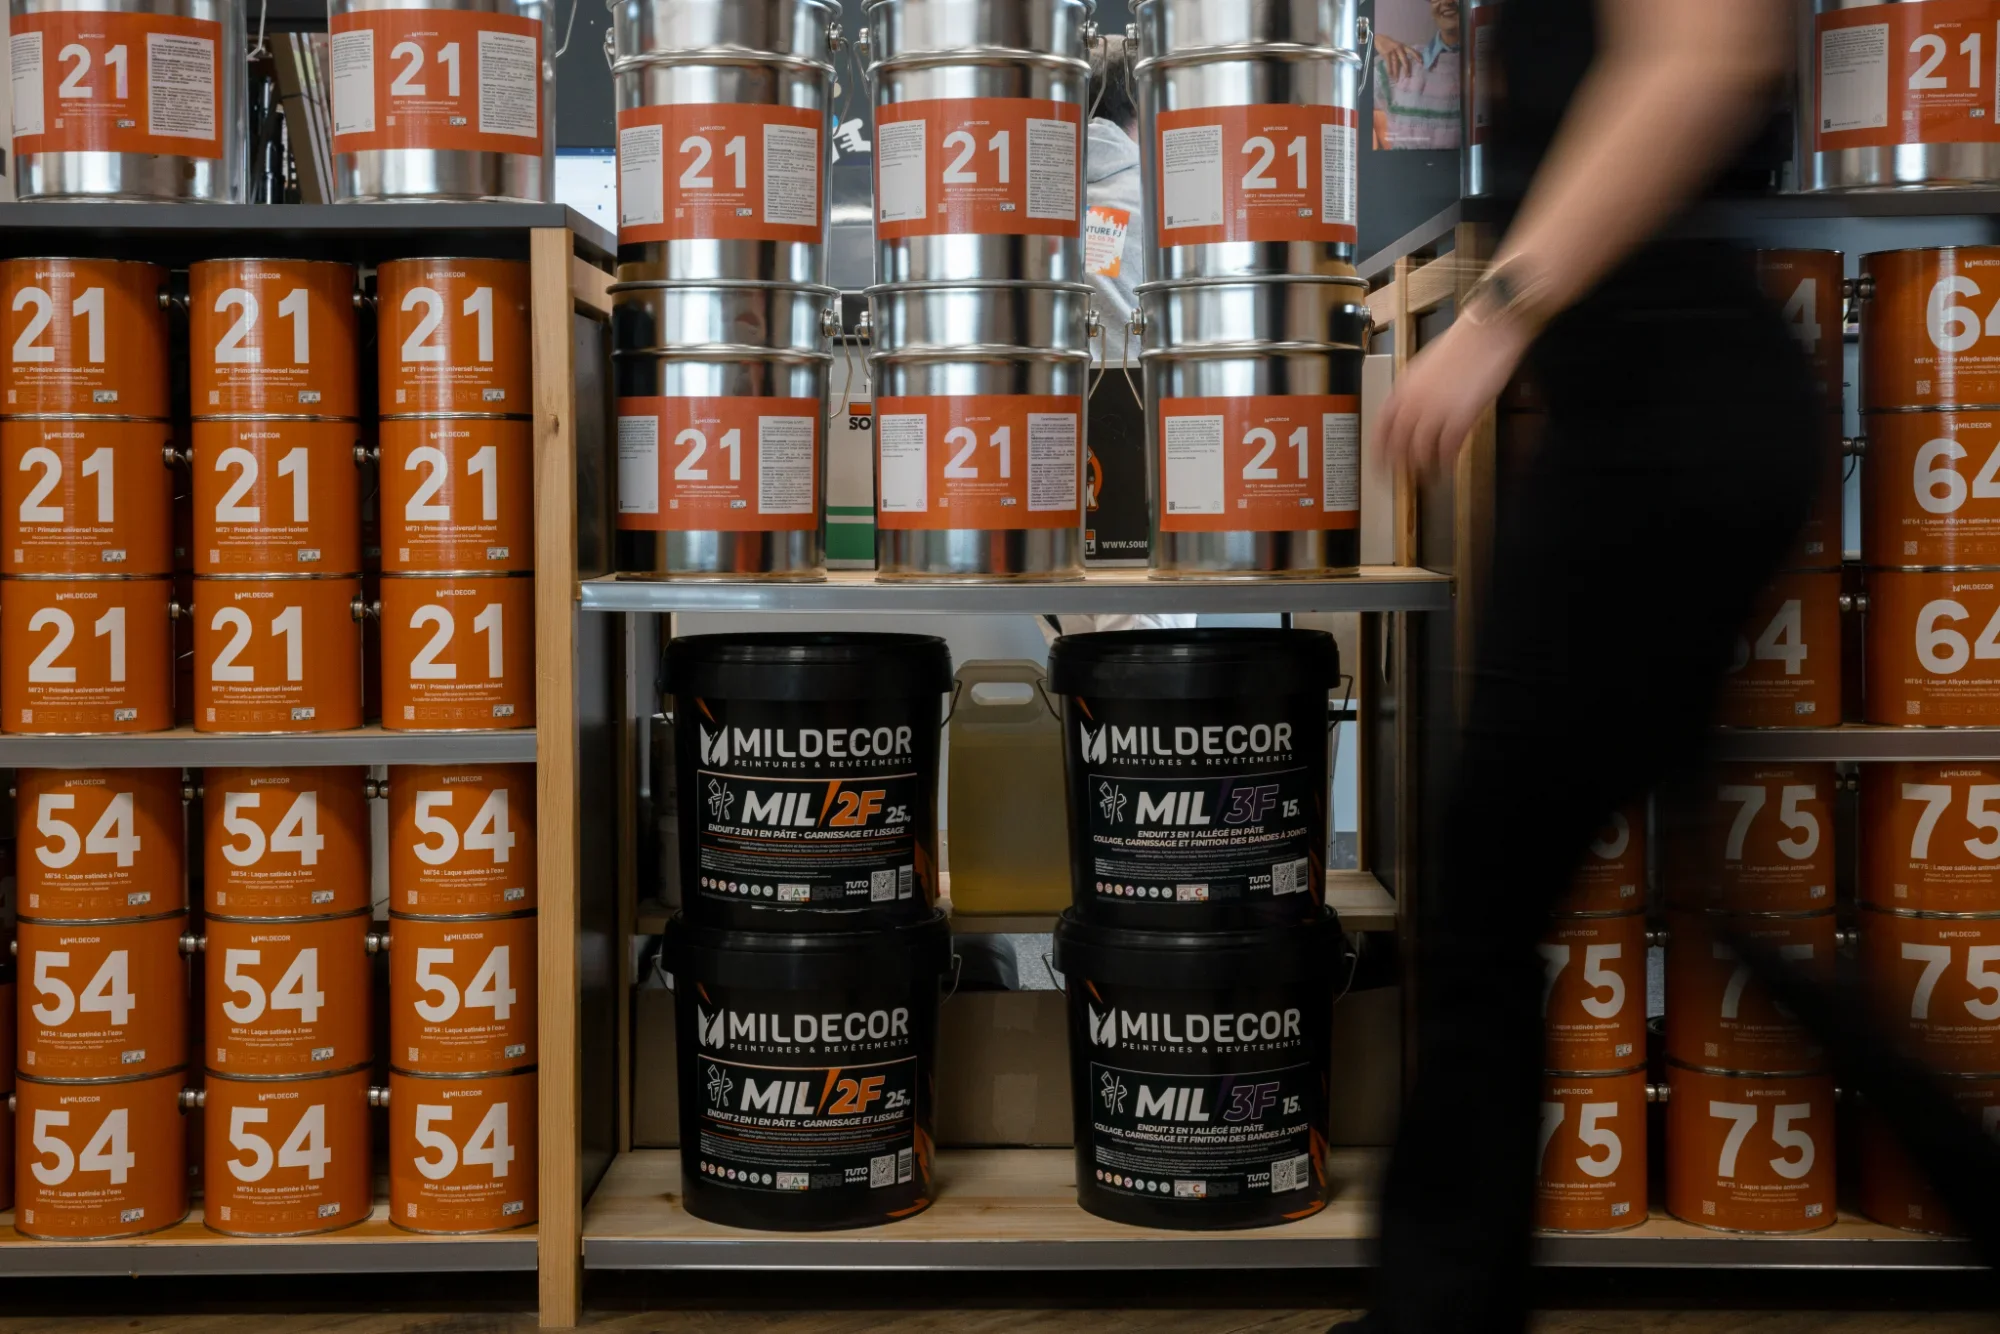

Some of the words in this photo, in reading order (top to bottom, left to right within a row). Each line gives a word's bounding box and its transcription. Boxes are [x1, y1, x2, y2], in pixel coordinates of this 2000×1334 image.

[58, 44, 128, 98] 21
[391, 42, 460, 97] 21
[1908, 33, 1981, 90] 21
[680, 136, 746, 188] 21
[943, 130, 1010, 183] 21
[1242, 136, 1308, 190] 21
[12, 286, 105, 363] 21
[214, 288, 310, 364] 21
[400, 286, 494, 362] 21
[674, 428, 741, 480] 21
[944, 426, 1011, 478] 21
[1242, 426, 1308, 480] 21
[19, 446, 114, 522] 21
[214, 447, 309, 522] 21
[404, 446, 498, 520] 21
[28, 607, 126, 682] 21
[211, 606, 302, 682] 21
[409, 604, 503, 679] 21
[734, 726, 912, 758] MILDECOR
[734, 760, 806, 768] PEINTURES
[830, 757, 912, 768] REVÊTEMENTS
[1111, 722, 1292, 755] MILDECOR
[1113, 757, 1182, 766] PEINTURES
[1207, 754, 1292, 766] REVÊTEMENTS
[35, 792, 142, 868] 54
[222, 791, 324, 866] 54
[412, 788, 516, 865] 54
[708, 824, 734, 834] ENDUIT
[742, 828, 753, 836] EN
[760, 830, 772, 838] EN
[773, 829, 797, 838] PÂTE
[804, 830, 862, 839] GARNISSAGE
[863, 828, 874, 838] ET
[875, 826, 904, 836] LISSAGE
[1094, 834, 1124, 846] COLLAGE,
[1126, 838, 1177, 848] GARNISSAGE
[1178, 838, 1189, 847] ET
[1190, 836, 1229, 847] FINITION
[1230, 836, 1247, 844] DES
[1248, 833, 1280, 844] BANDES
[1286, 827, 1308, 839] JOINTS
[1138, 830, 1168, 838] ENDUIT
[1177, 830, 1190, 838] EN
[1196, 828, 1230, 838] ALLÉGÉ
[1230, 828, 1243, 838] EN
[1244, 826, 1264, 836] PÂTE
[1718, 784, 1820, 860] 75
[1902, 783, 2000, 860] 75
[270, 870, 292, 878] satinée
[845, 880, 869, 889] TUTO
[1249, 874, 1272, 884] TUTO
[1948, 930, 1981, 938] MILDECOR
[32, 950, 136, 1026] 54
[222, 948, 325, 1024] 54
[414, 946, 517, 1024] 54
[1539, 943, 1626, 1018] 75
[1901, 942, 2000, 1020] 75
[730, 1008, 909, 1043] MILDECOR
[730, 1044, 800, 1053] PEINTURES
[825, 1038, 909, 1053] REVÊTEMENTS
[1121, 1008, 1301, 1042] MILDECOR
[1122, 1042, 1192, 1053] PEINTURES
[1218, 1039, 1301, 1053] REVÊTEMENTS
[226, 1104, 332, 1182] 54
[414, 1102, 515, 1180] 54
[708, 1108, 733, 1120] ENDUIT
[740, 1116, 752, 1124] EN
[758, 1118, 770, 1126] EN
[772, 1116, 796, 1127] PÂTE
[802, 1117, 861, 1128] GARNISSAGE
[862, 1116, 873, 1125] ET
[874, 1110, 904, 1123] LISSAGE
[1094, 1122, 1124, 1137] COLLAGE,
[1125, 1130, 1176, 1143] GARNISSAGE
[1177, 1134, 1188, 1143] ET
[1190, 1134, 1228, 1143] FINITION
[1229, 1134, 1246, 1142] DES
[1248, 1130, 1278, 1141] BANDES
[1286, 1122, 1308, 1136] JOINTS
[1137, 1124, 1168, 1134] ENDUIT
[1176, 1126, 1188, 1134] EN
[1194, 1124, 1228, 1134] ALLÉGÉ
[1230, 1125, 1242, 1134] EN
[1244, 1122, 1264, 1132] PÂTE
[1710, 1101, 1816, 1180] 75
[31, 1108, 135, 1186] 54
[844, 1166, 868, 1176] TUTO
[1247, 1172, 1270, 1182] TUTO
[1567, 1181, 1588, 1189] satinée
